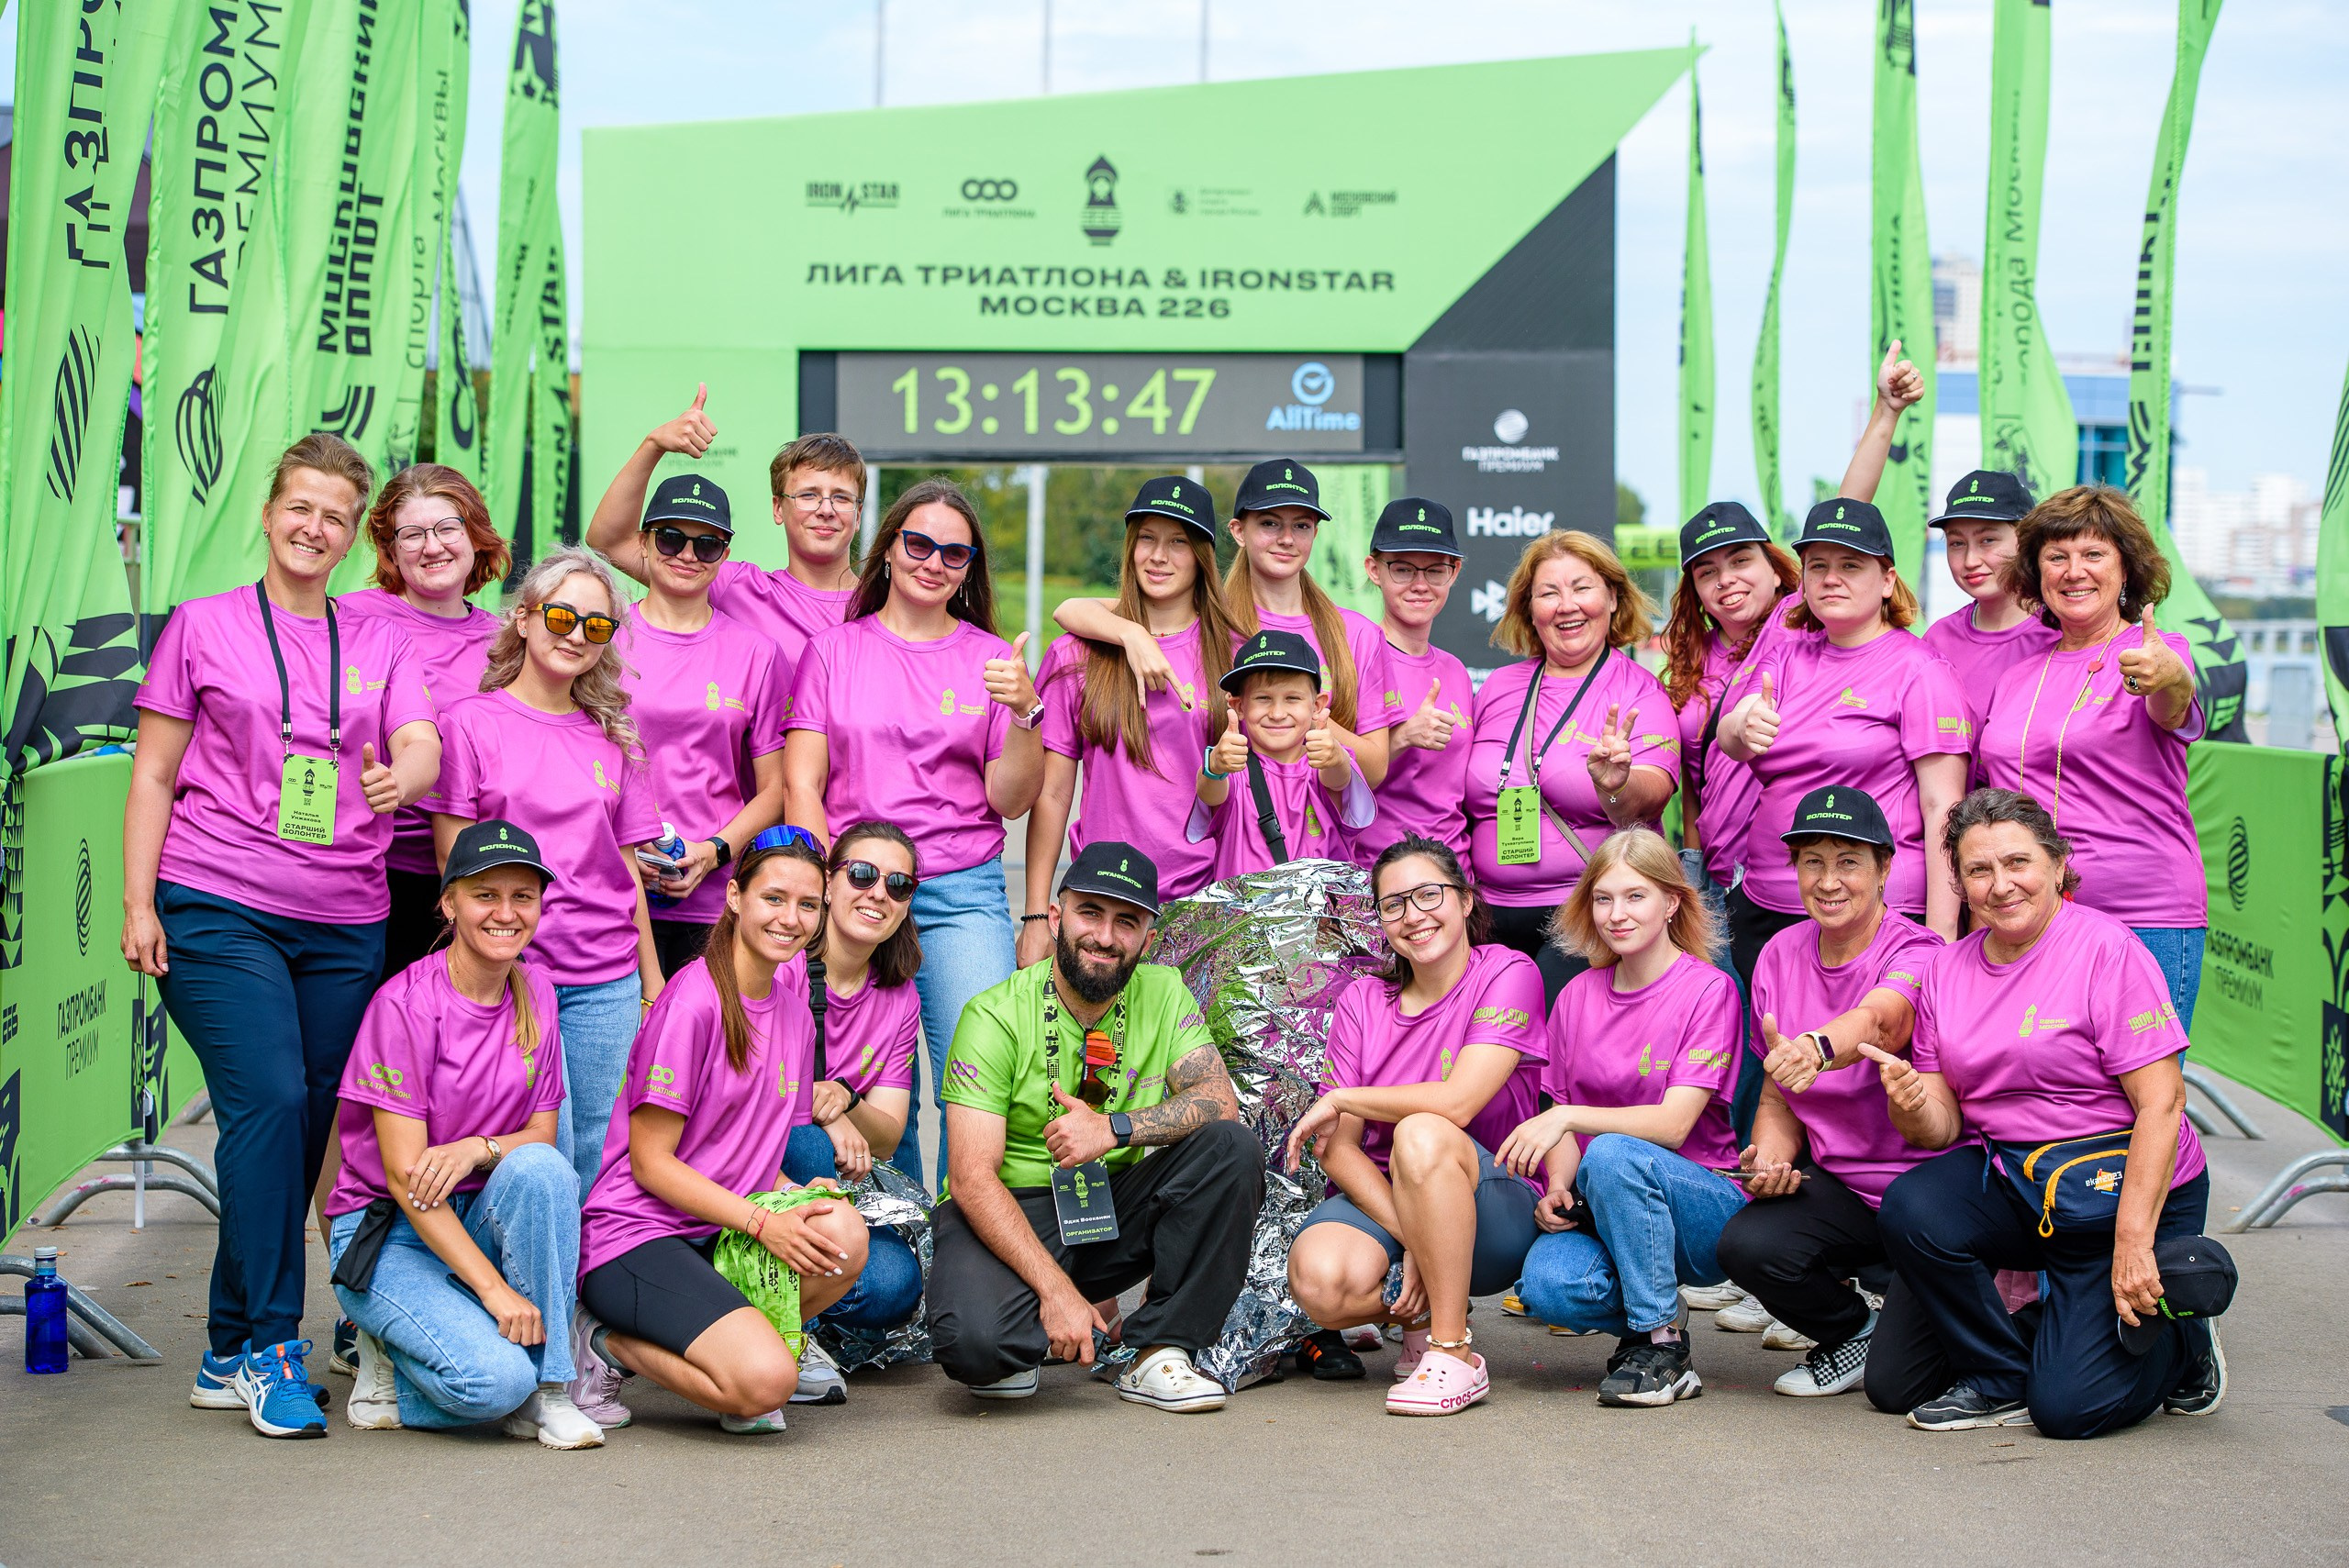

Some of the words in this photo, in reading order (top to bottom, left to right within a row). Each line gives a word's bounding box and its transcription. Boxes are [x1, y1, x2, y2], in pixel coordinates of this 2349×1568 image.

[235, 0, 283, 270] ЕМИУМ
[189, 0, 239, 316] ГАЗПРОМ
[807, 263, 904, 285] ЛИГА
[915, 265, 1151, 289] ТРИАТЛОНА
[1163, 268, 1188, 289] &
[1200, 269, 1395, 293] IRONSTAR
[980, 295, 1146, 317] МОСКВА
[1158, 297, 1231, 319] 226
[892, 366, 1218, 436] 13:13:47
[1265, 404, 1362, 432] AllTime
[1265, 483, 1309, 495] ВОЛОНТЕР
[672, 497, 717, 511] ВОЛОНТЕР
[1151, 499, 1195, 516] ВОЛОНТЕР
[1953, 495, 1995, 506] ВОЛОНТЕР
[1467, 505, 1556, 537] Haier
[1816, 523, 1862, 533] ВОЛОНТЕР
[1398, 524, 1442, 535] ВОЛОНТЕР
[1695, 526, 1737, 545] ВОЛОНТЕР
[1243, 650, 1286, 665] ВОЛОНТЕР
[1937, 717, 1958, 729] IRON
[1806, 813, 1853, 823] ВОЛОНТЕР
[283, 828, 327, 840] ВОЛОНТЕР
[284, 822, 326, 834] СТАРШИЙ
[478, 842, 529, 853] ВОЛОНТЕР
[1502, 847, 1533, 855] СТАРШИЙ
[1501, 852, 1535, 861] ВОЛОНТЕР
[1097, 871, 1142, 889] ОРГАНИЗАТОР
[57, 978, 106, 1040] ГАЗПРОМБАНК
[1508, 1008, 1530, 1026] STAR
[2128, 1010, 2155, 1031] IRON
[2161, 1001, 2176, 1017] ST
[65, 1027, 99, 1081] ПРЕМИУМ
[1688, 1049, 1712, 1061] IRON
[1721, 1051, 1732, 1065] ST
[356, 1078, 373, 1088] ЛИГА
[1065, 1226, 1113, 1237] ОРГАНИЗАТОР
[1441, 1391, 1472, 1409] crocs
